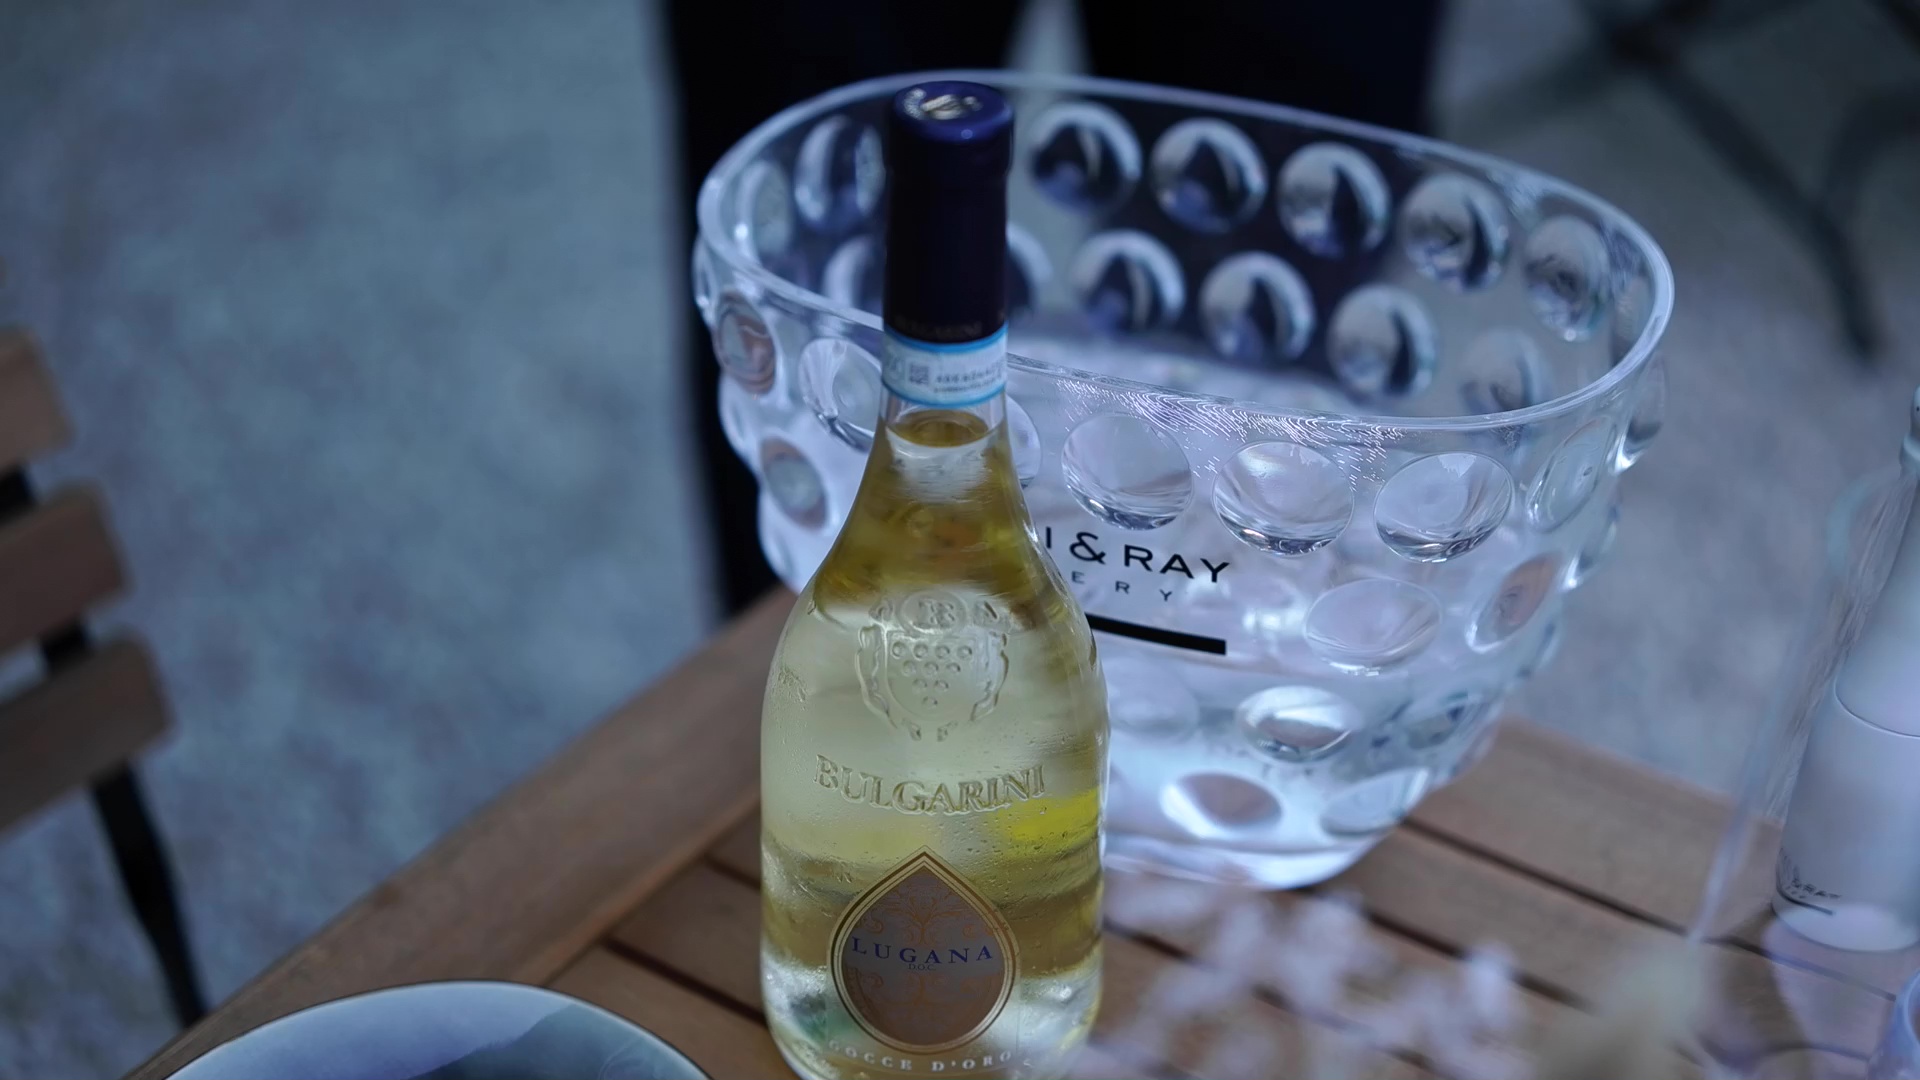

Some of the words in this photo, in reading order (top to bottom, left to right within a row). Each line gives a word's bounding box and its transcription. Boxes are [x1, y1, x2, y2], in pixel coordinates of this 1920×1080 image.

[1070, 570, 1173, 602] ERY
[813, 753, 1046, 816] BULGARINI
[851, 936, 994, 965] LUGANA
[828, 1038, 913, 1072] GOCCE
[931, 1050, 1012, 1073] D'ORO
